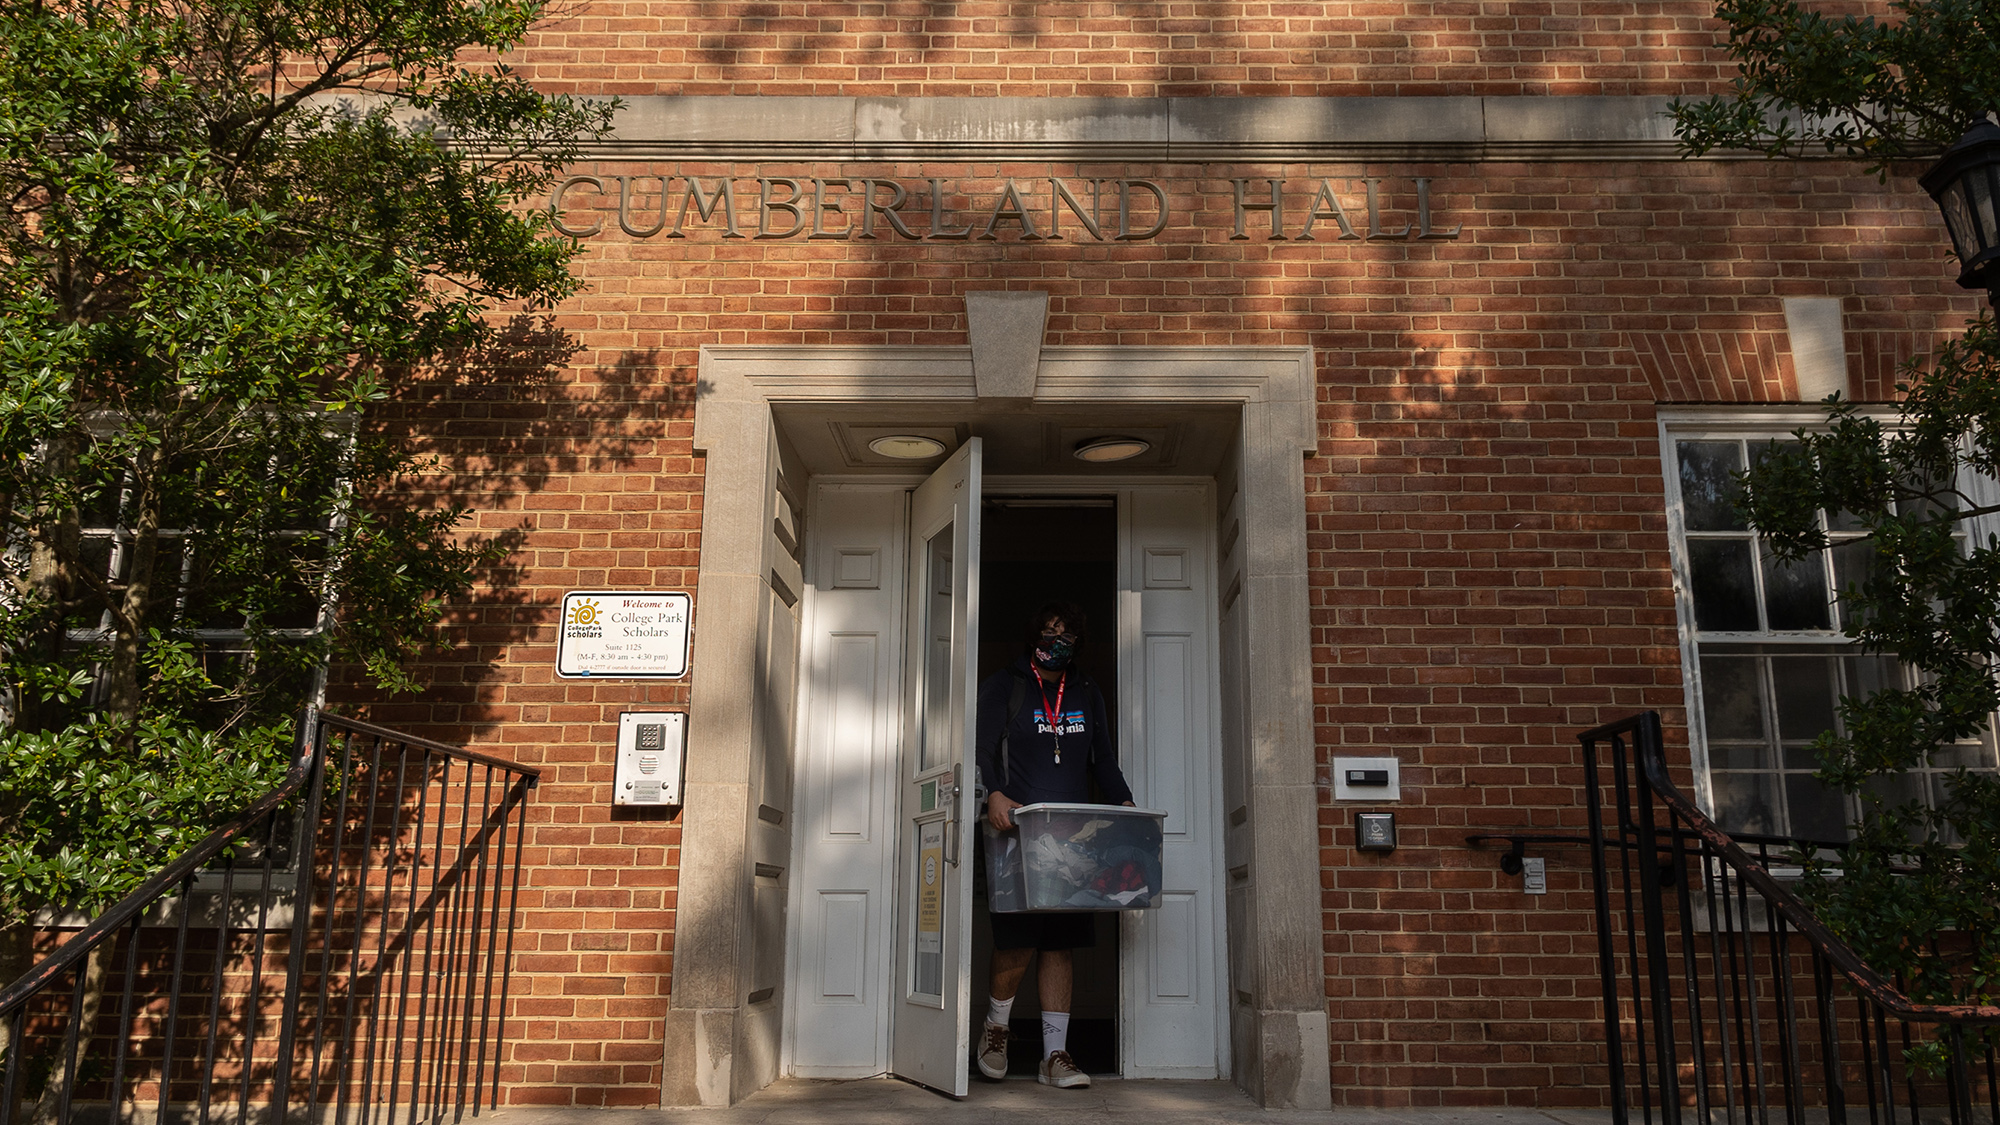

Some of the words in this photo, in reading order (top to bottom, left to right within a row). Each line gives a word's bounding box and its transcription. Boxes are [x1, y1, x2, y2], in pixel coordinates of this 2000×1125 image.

[549, 175, 1170, 240] CUMBERLAND
[1228, 177, 1463, 241] HALL
[622, 600, 662, 608] Welcome
[665, 600, 674, 608] to
[611, 612, 653, 626] College
[658, 613, 683, 623] Park
[623, 627, 669, 637] Scholars
[653, 654, 669, 662] pm)
